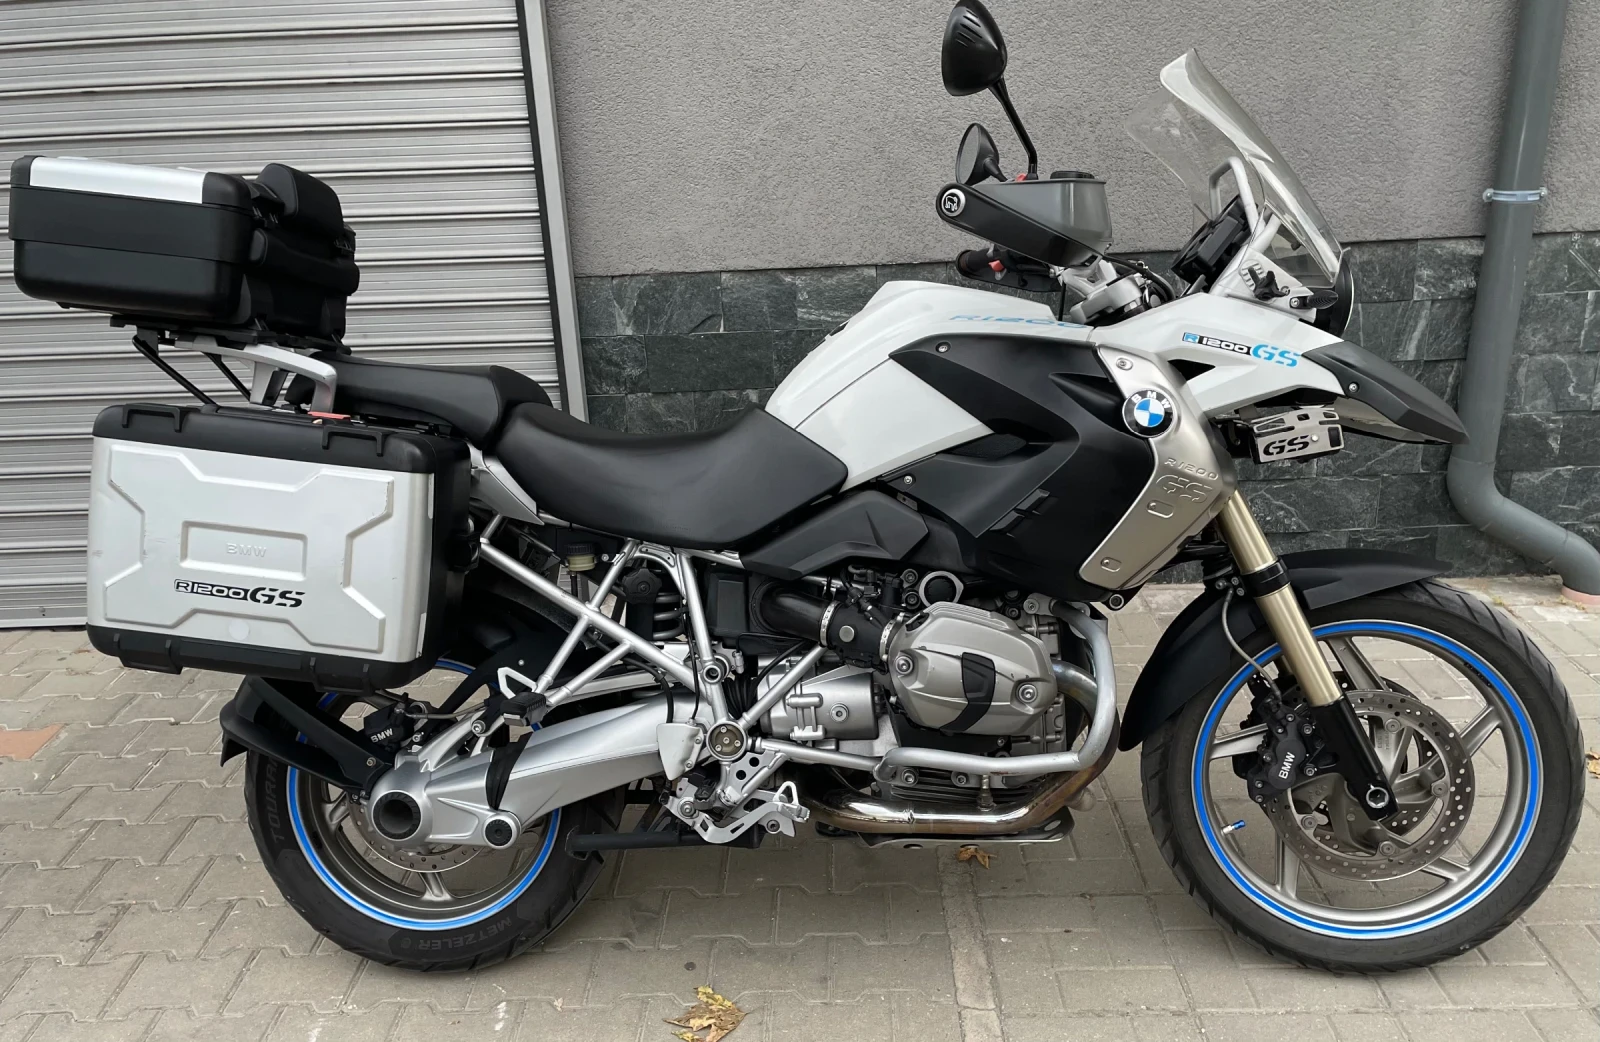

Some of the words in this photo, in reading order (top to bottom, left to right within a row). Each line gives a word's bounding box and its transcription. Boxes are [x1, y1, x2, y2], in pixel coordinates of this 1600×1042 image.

[1131, 390, 1171, 409] BMW
[1263, 435, 1310, 457] GS
[1164, 457, 1219, 480] R1200
[1156, 474, 1213, 503] GS
[226, 542, 267, 557] BMW
[370, 728, 393, 743] BMW
[1278, 751, 1296, 779] BMW
[418, 916, 513, 950] METZELER
